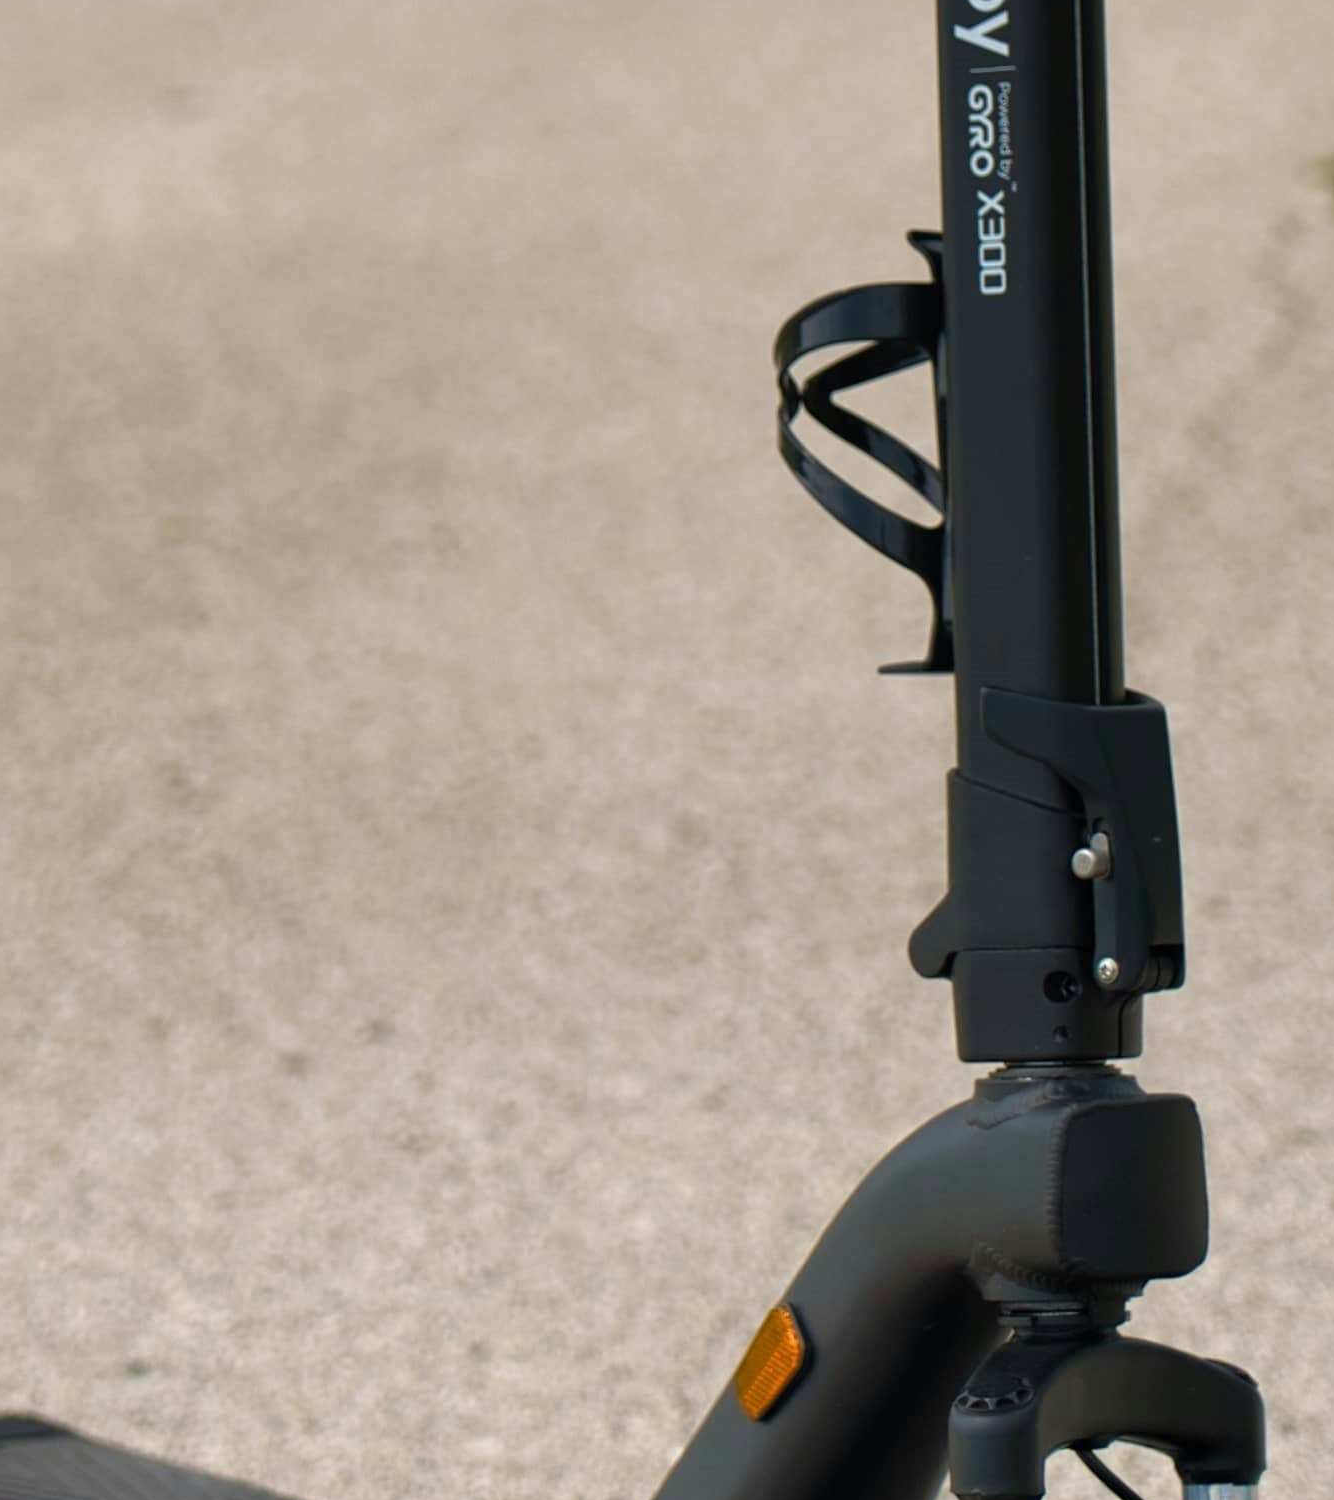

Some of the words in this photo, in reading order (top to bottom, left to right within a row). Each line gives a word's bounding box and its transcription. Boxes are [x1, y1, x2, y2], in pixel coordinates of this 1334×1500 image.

[967, 83, 995, 178] GYRO
[996, 81, 1013, 156] Powered
[996, 158, 1013, 181] by
[976, 189, 1008, 296] X300
